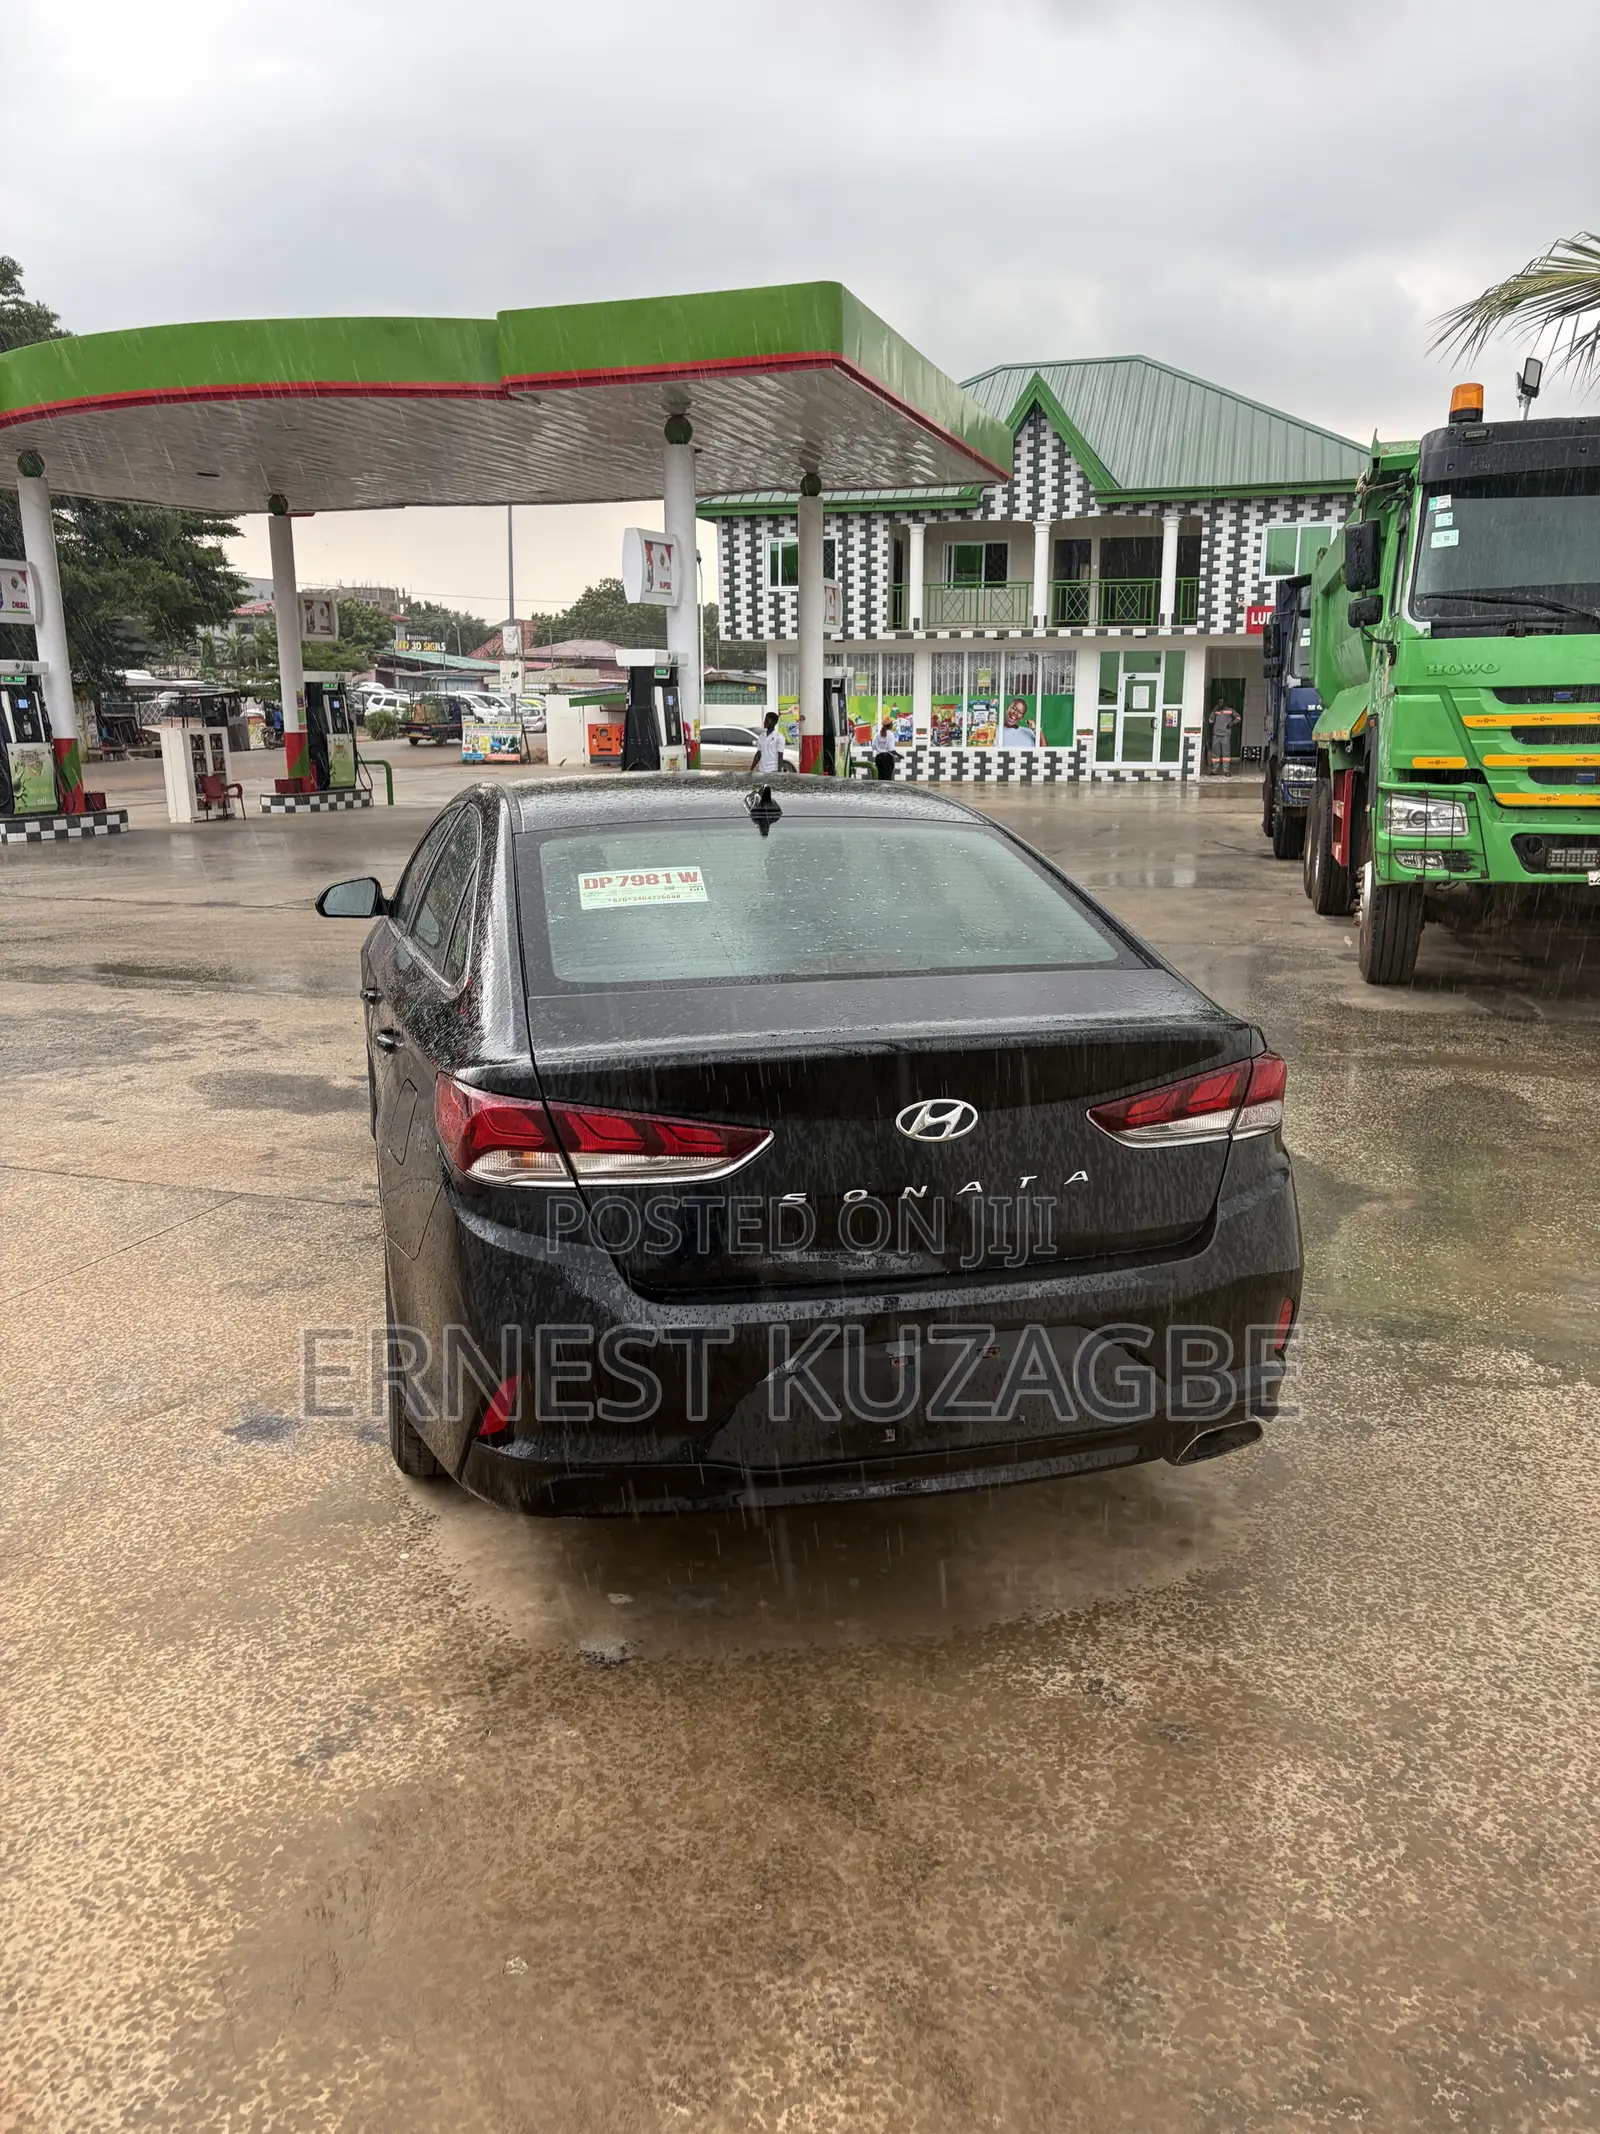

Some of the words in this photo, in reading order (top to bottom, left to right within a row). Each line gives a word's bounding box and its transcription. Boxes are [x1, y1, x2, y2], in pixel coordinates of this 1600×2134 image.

[411, 641, 422, 651] 3D
[1426, 664, 1500, 677] HOWO
[583, 877, 613, 890] DP
[616, 873, 673, 887] 7981
[677, 871, 698, 883] W
[779, 1170, 1089, 1206] SONATA
